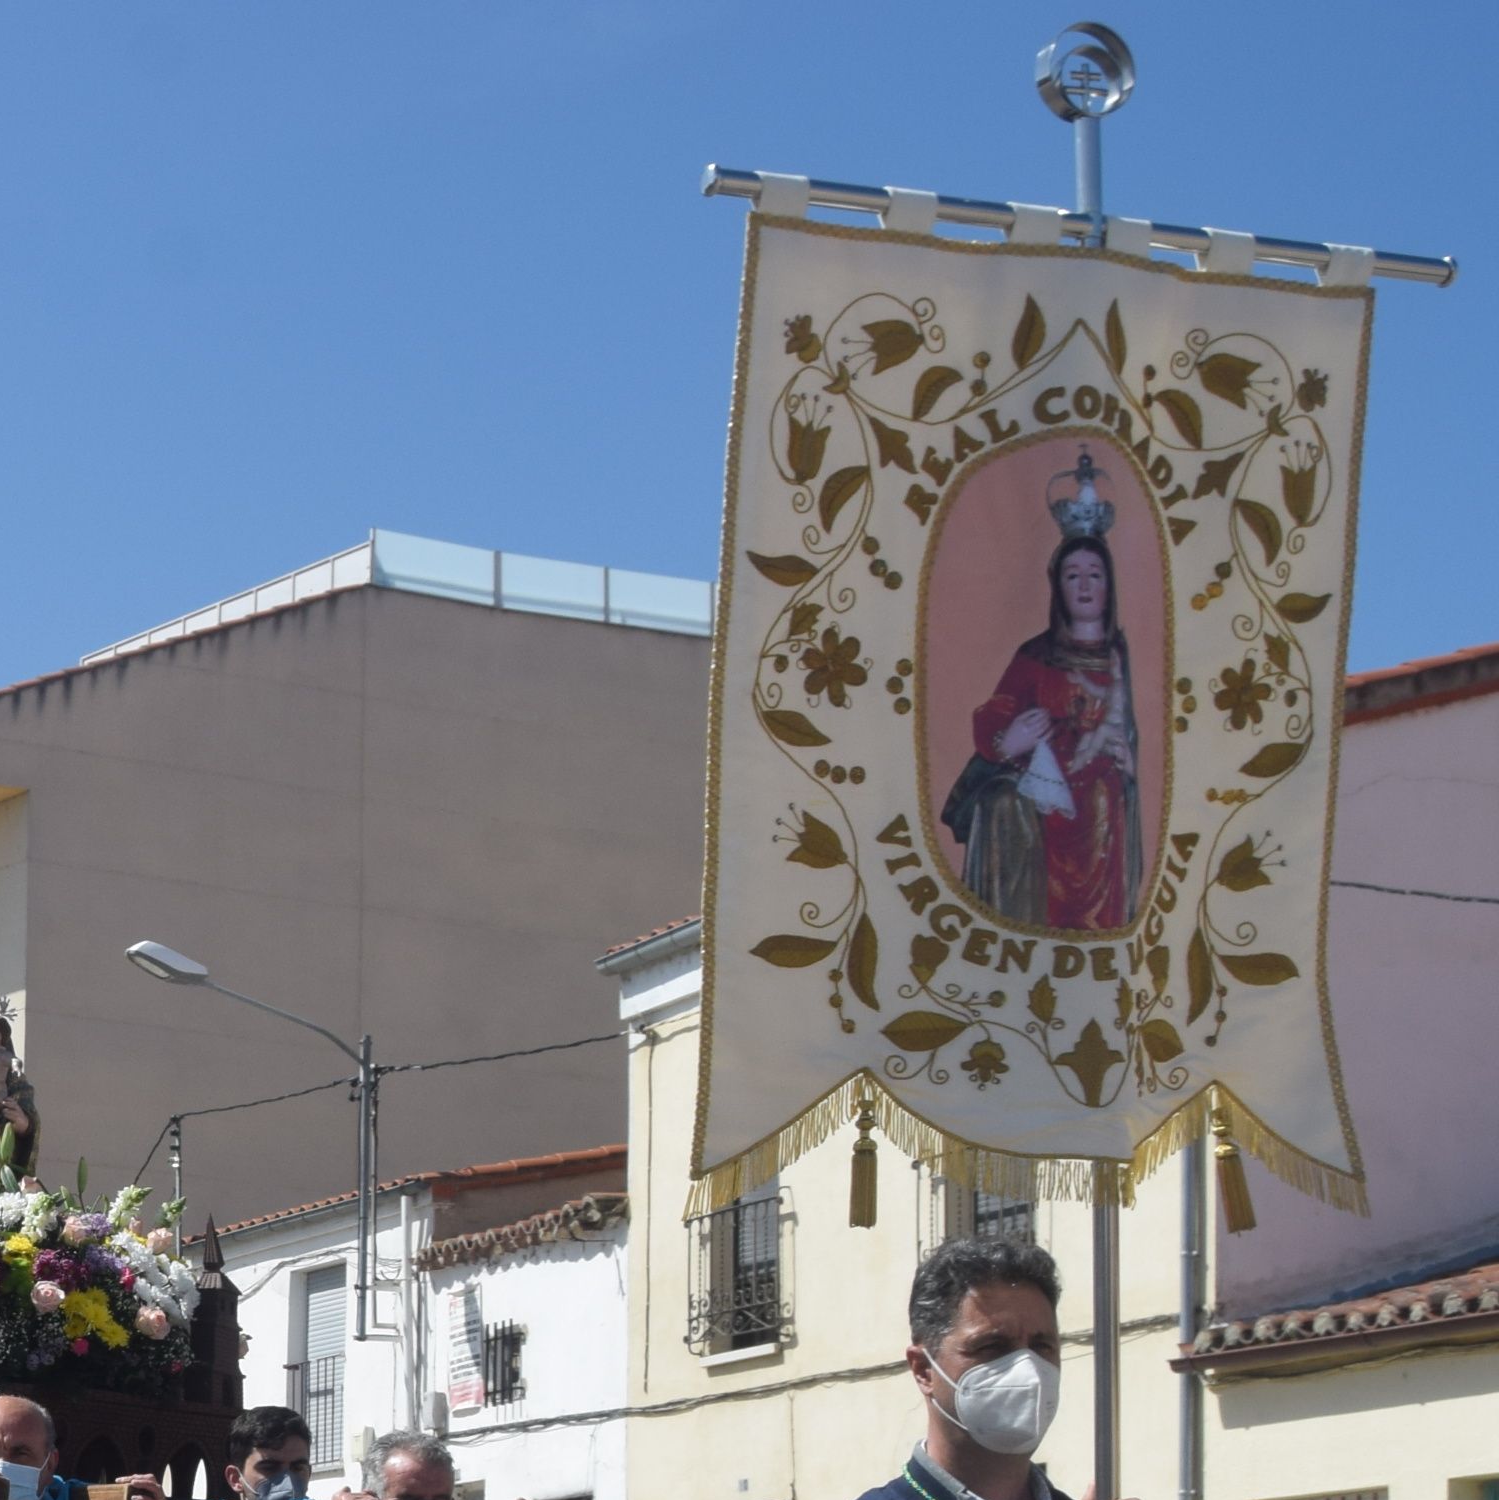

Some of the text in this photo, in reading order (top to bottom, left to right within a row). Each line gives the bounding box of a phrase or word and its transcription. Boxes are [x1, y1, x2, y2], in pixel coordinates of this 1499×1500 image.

[904, 408, 1021, 527] REAL
[875, 812, 1038, 974] VIRGEN
[1052, 945, 1120, 982] DE
